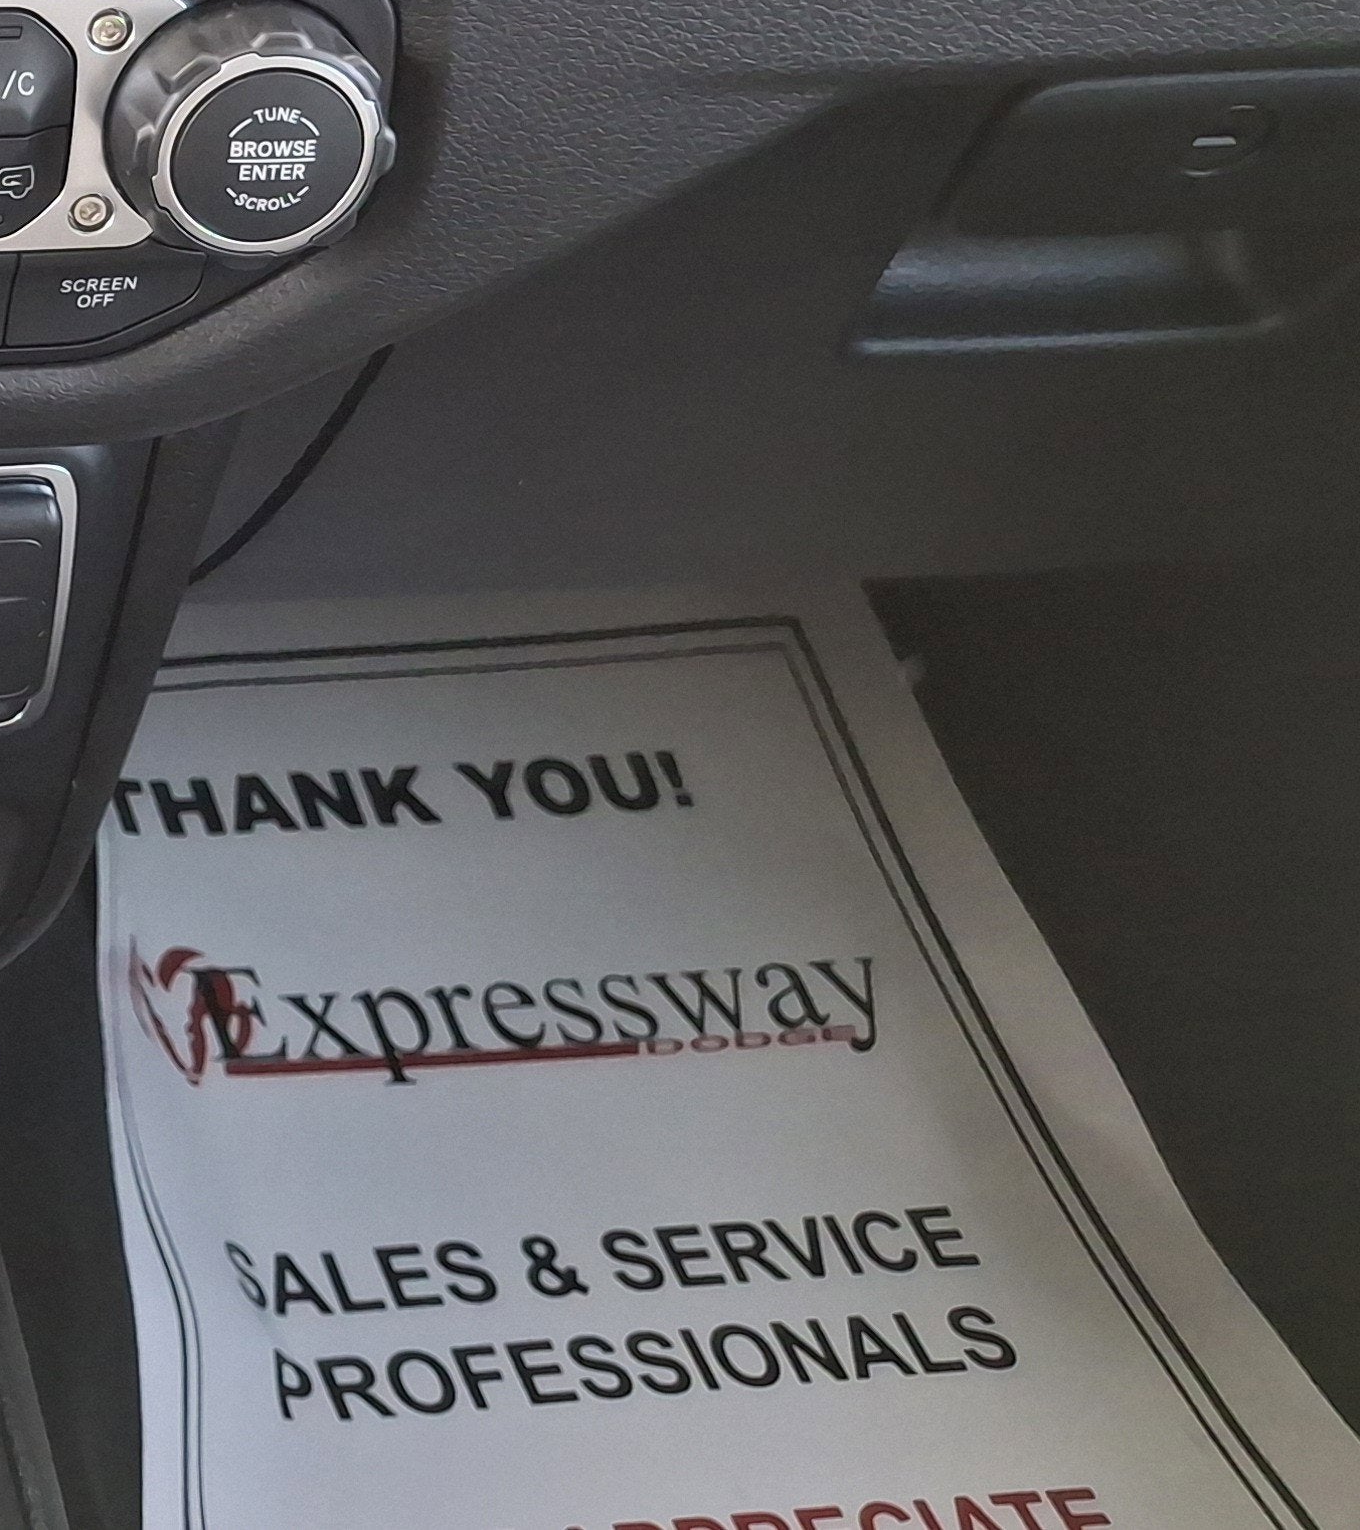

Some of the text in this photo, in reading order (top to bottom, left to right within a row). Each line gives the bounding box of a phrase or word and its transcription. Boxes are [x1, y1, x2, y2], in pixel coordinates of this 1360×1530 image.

[252, 107, 302, 127] TUNE
[229, 139, 317, 160] BROWSE
[237, 162, 306, 183] ENTER
[233, 190, 303, 213] SCROLL
[59, 276, 139, 295] SCREEN
[76, 293, 115, 310] OFF
[112, 750, 695, 839] THANK YOU!
[186, 954, 877, 1085] Expressway
[225, 1206, 981, 1318] SALES & SERVICE
[273, 1306, 1018, 1421] PROFESSIONALS
